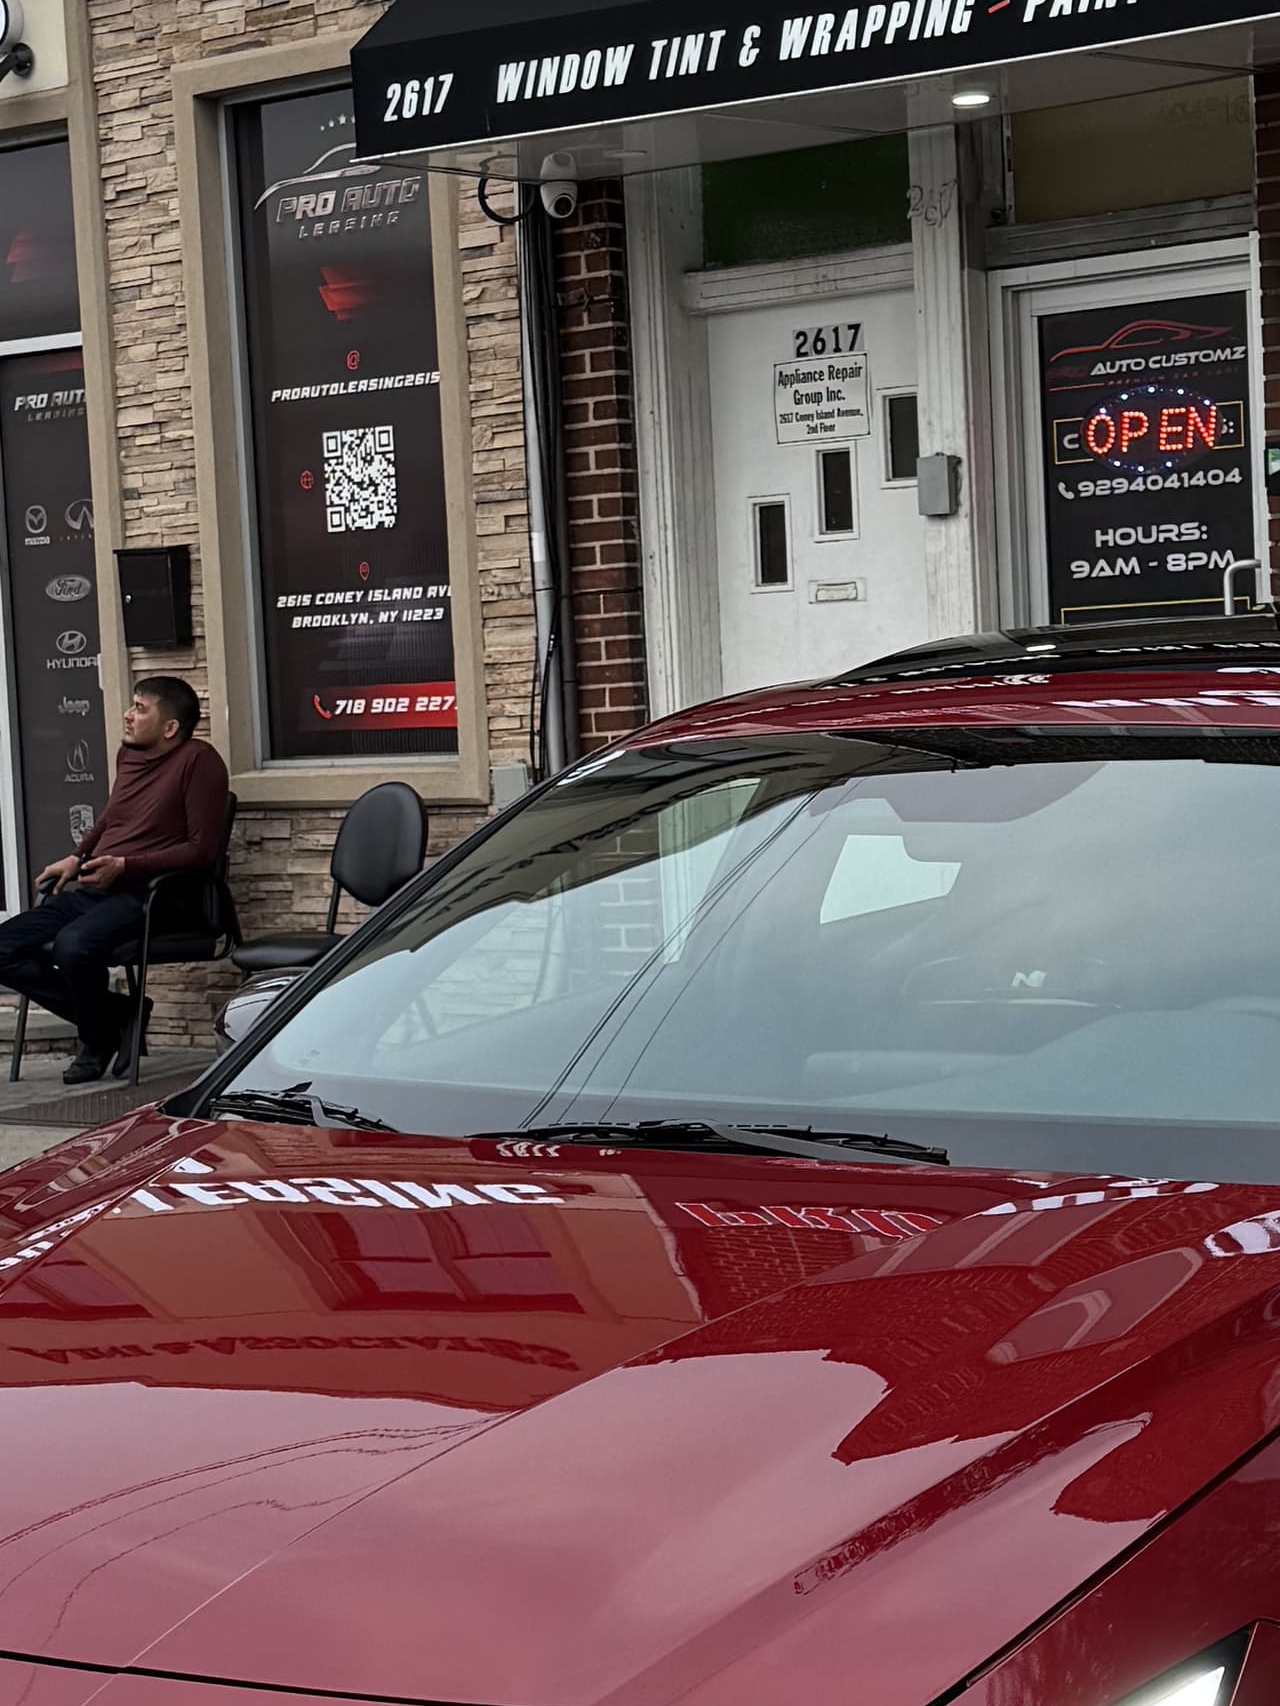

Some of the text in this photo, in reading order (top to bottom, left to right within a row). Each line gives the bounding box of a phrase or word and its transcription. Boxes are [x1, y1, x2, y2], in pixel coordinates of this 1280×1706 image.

[383, 73, 454, 122] 2617
[496, 44, 635, 104] WINDOW
[648, 29, 726, 81] TINT
[739, 24, 761, 67] &
[276, 176, 422, 222] PRO AUTO
[299, 211, 400, 238] LEASING
[795, 323, 862, 358] 2617
[346, 350, 361, 370] @
[1090, 358, 1145, 376] AUTO
[1148, 346, 1247, 368] CUSTOMZ
[271, 371, 440, 402] PROAUTOLEASING2615
[778, 361, 863, 389] Appliance Repair
[14, 389, 86, 411] PRO AUT
[793, 386, 846, 406] Group Inc.
[1085, 405, 1217, 455] OPEN
[1077, 467, 1243, 497] 9294041404
[1095, 522, 1208, 548] HOURS:
[1070, 556, 1141, 579] 9AM
[1166, 549, 1236, 573] 8PM
[276, 594, 312, 608] 2615
[315, 591, 365, 606] CONEY
[367, 587, 423, 602] ISLAND
[378, 610, 398, 623] NY
[402, 607, 444, 621] 11223
[46, 657, 98, 670] HYUNDA
[334, 695, 457, 715] 718 902 227
